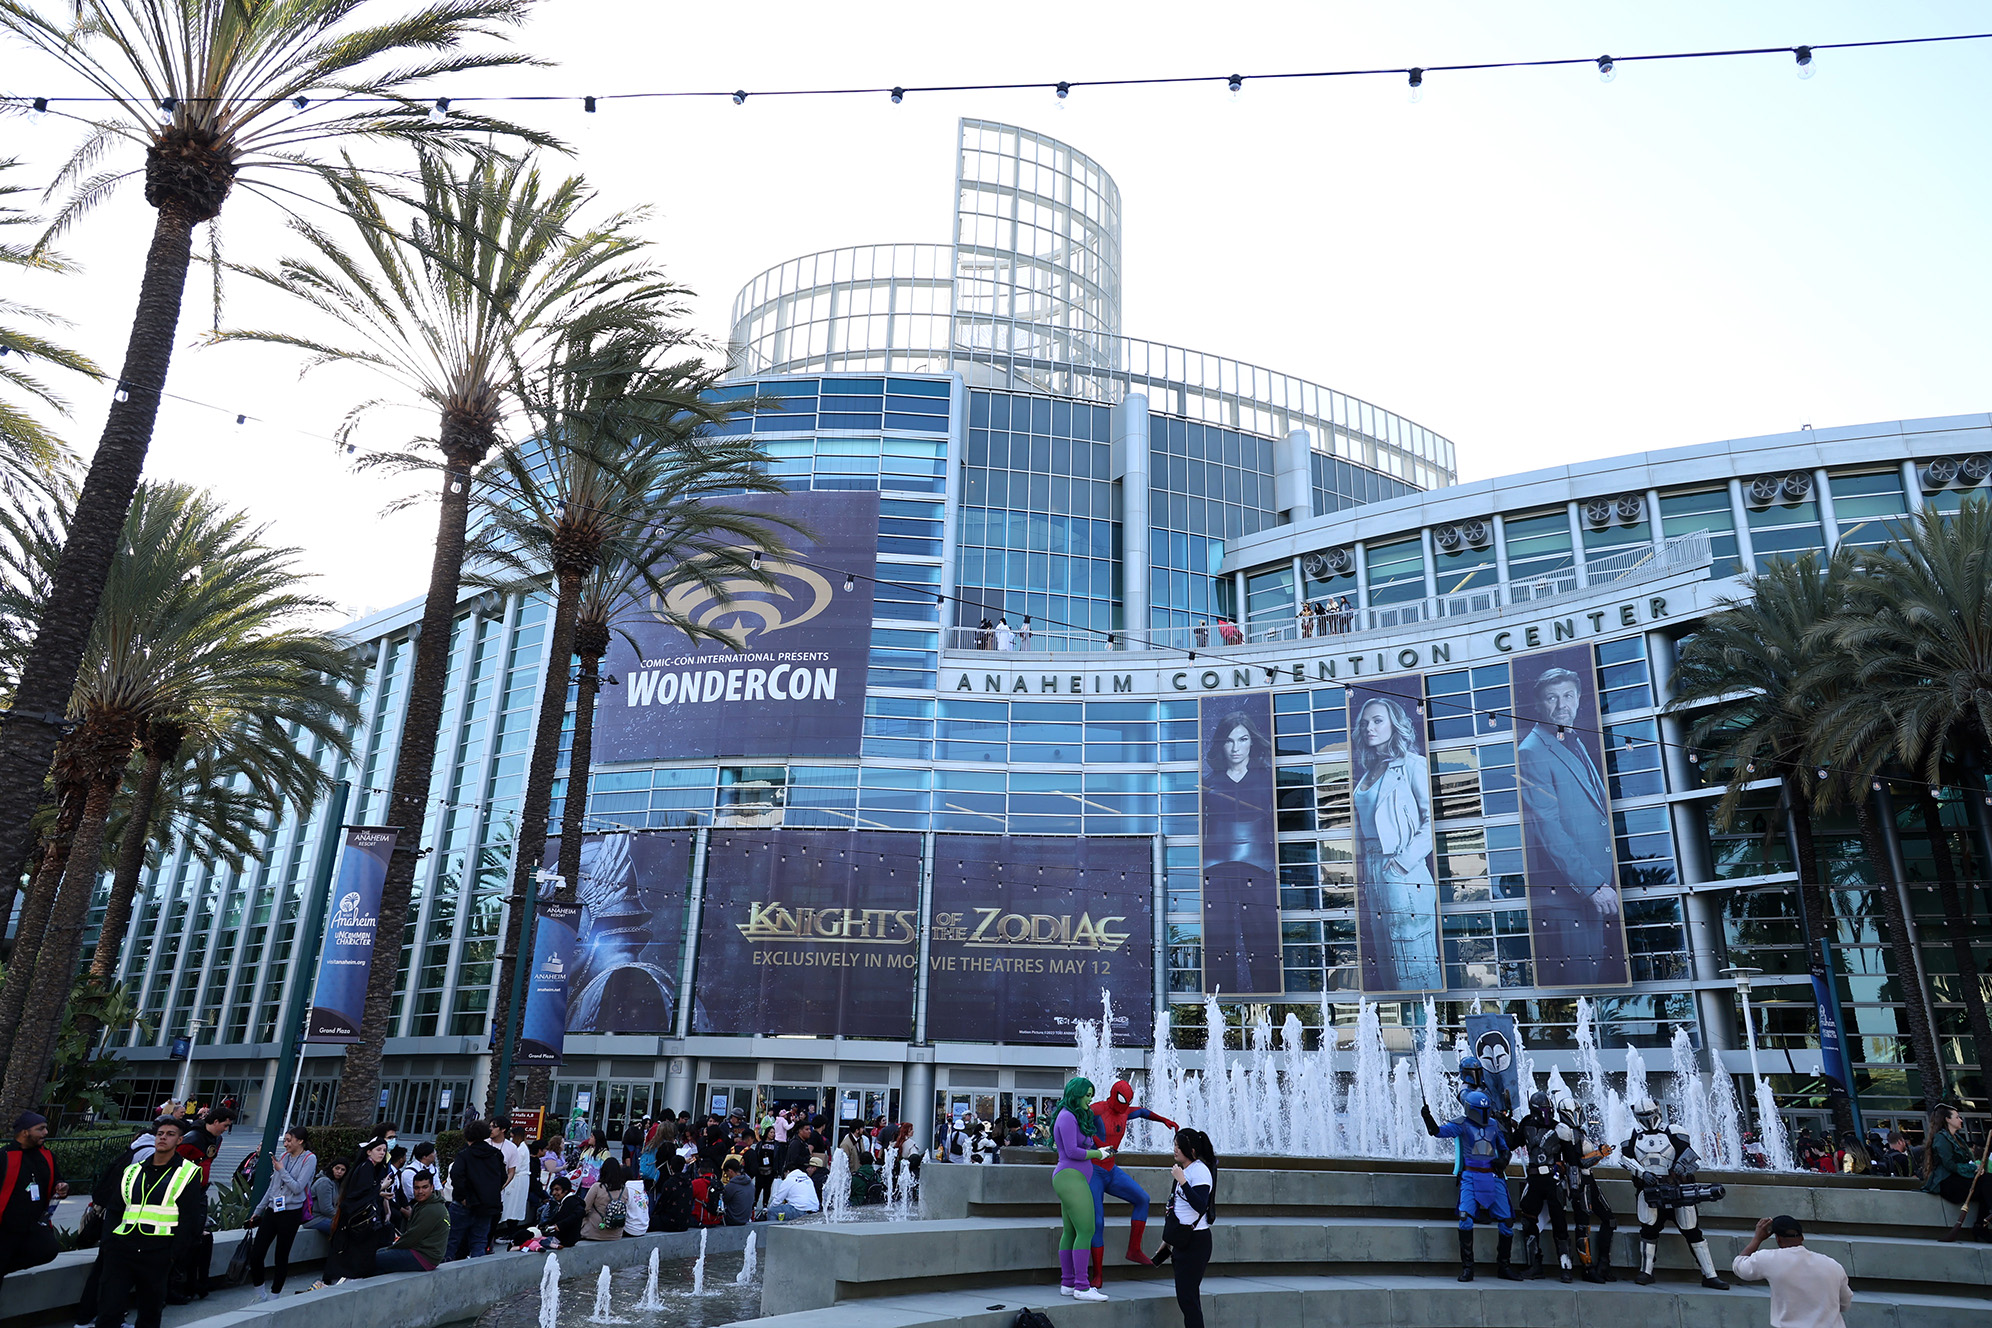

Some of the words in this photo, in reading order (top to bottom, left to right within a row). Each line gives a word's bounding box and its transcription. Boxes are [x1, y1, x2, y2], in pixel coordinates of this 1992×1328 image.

[956, 672, 1134, 694] ANAHEIM
[1171, 642, 1451, 690] CONVENTION
[1493, 596, 1669, 653] CENTER
[640, 656, 695, 669] COMIC-CON
[697, 653, 775, 664] INTERNATIONAL
[778, 652, 829, 661] PRESENTS
[354, 834, 390, 842] ANAHEIM
[330, 907, 376, 929] Anaheim
[546, 907, 577, 915] ANAHEIM
[935, 912, 964, 926] OF
[737, 901, 917, 945] KNIGHTS
[963, 907, 1131, 951] ZODIAC
[931, 926, 968, 941] THE
[336, 938, 372, 946] CHARACTER
[752, 951, 860, 967] EXCLUSIVELY
[864, 953, 882, 968] IN
[960, 957, 1044, 973] THEATRES
[1049, 958, 1086, 974] MAY
[1092, 961, 1111, 975] 12
[318, 1026, 336, 1034] Grand
